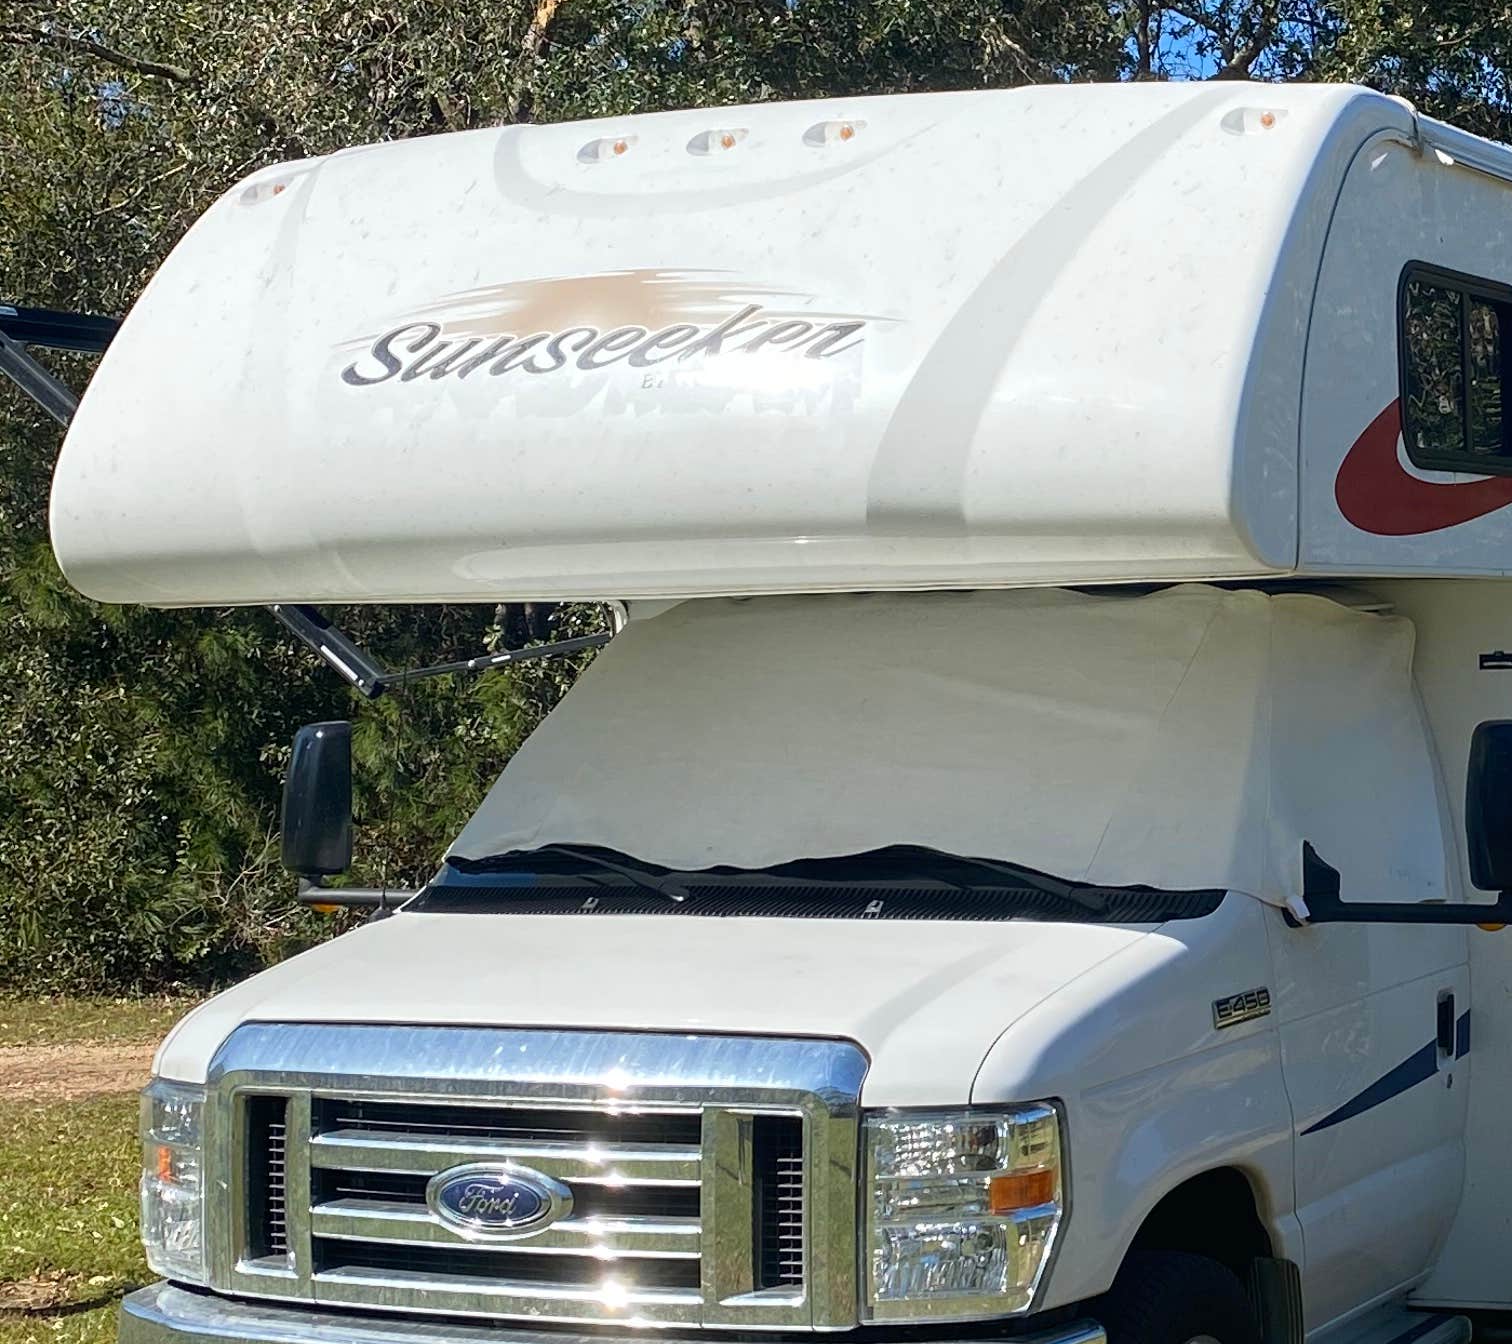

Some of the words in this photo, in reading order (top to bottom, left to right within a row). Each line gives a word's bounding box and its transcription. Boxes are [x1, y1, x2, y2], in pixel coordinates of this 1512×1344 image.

[341, 304, 867, 386] Sunseeker
[1213, 988, 1271, 1021] E-450
[459, 1183, 520, 1215] Ford
